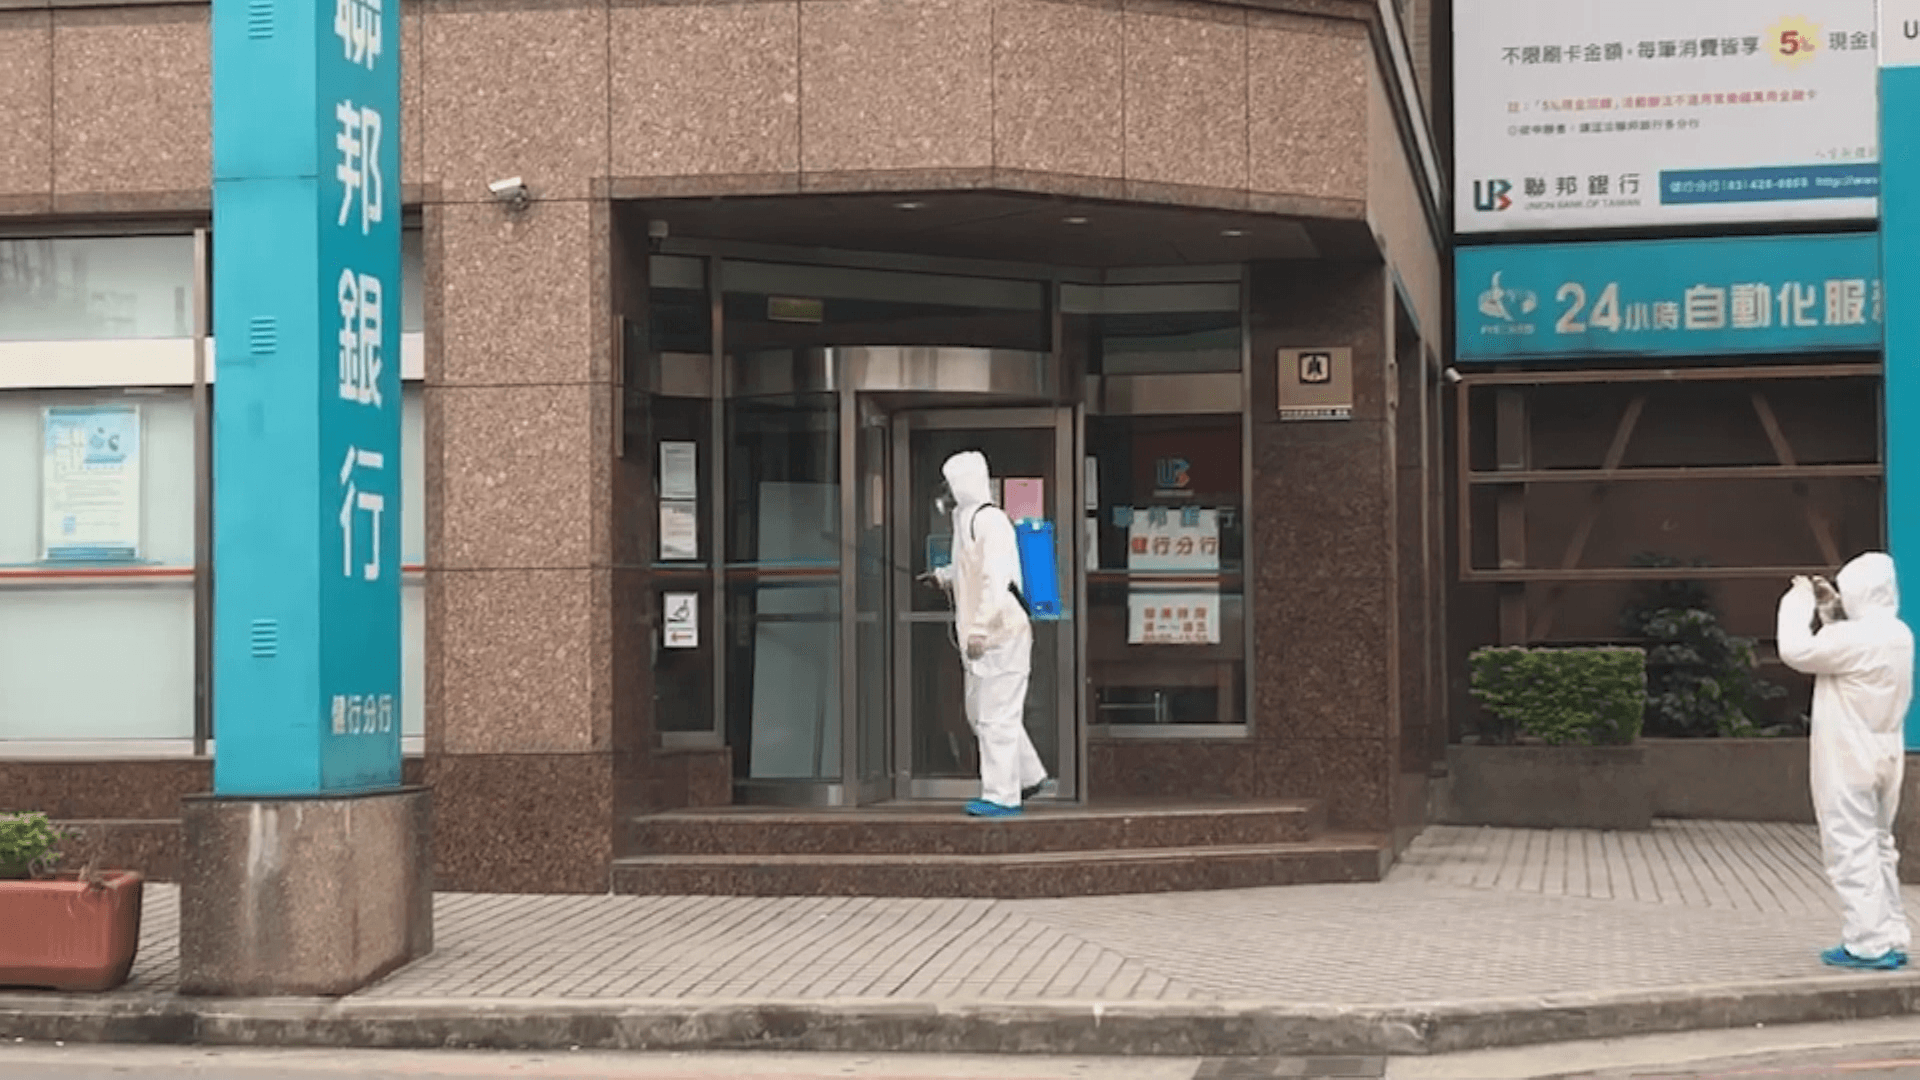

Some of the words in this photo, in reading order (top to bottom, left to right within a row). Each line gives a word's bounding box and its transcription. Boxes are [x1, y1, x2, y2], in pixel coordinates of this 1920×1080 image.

[1829, 31, 1876, 51] 現金
[1524, 173, 1640, 197] 聯邦銀行
